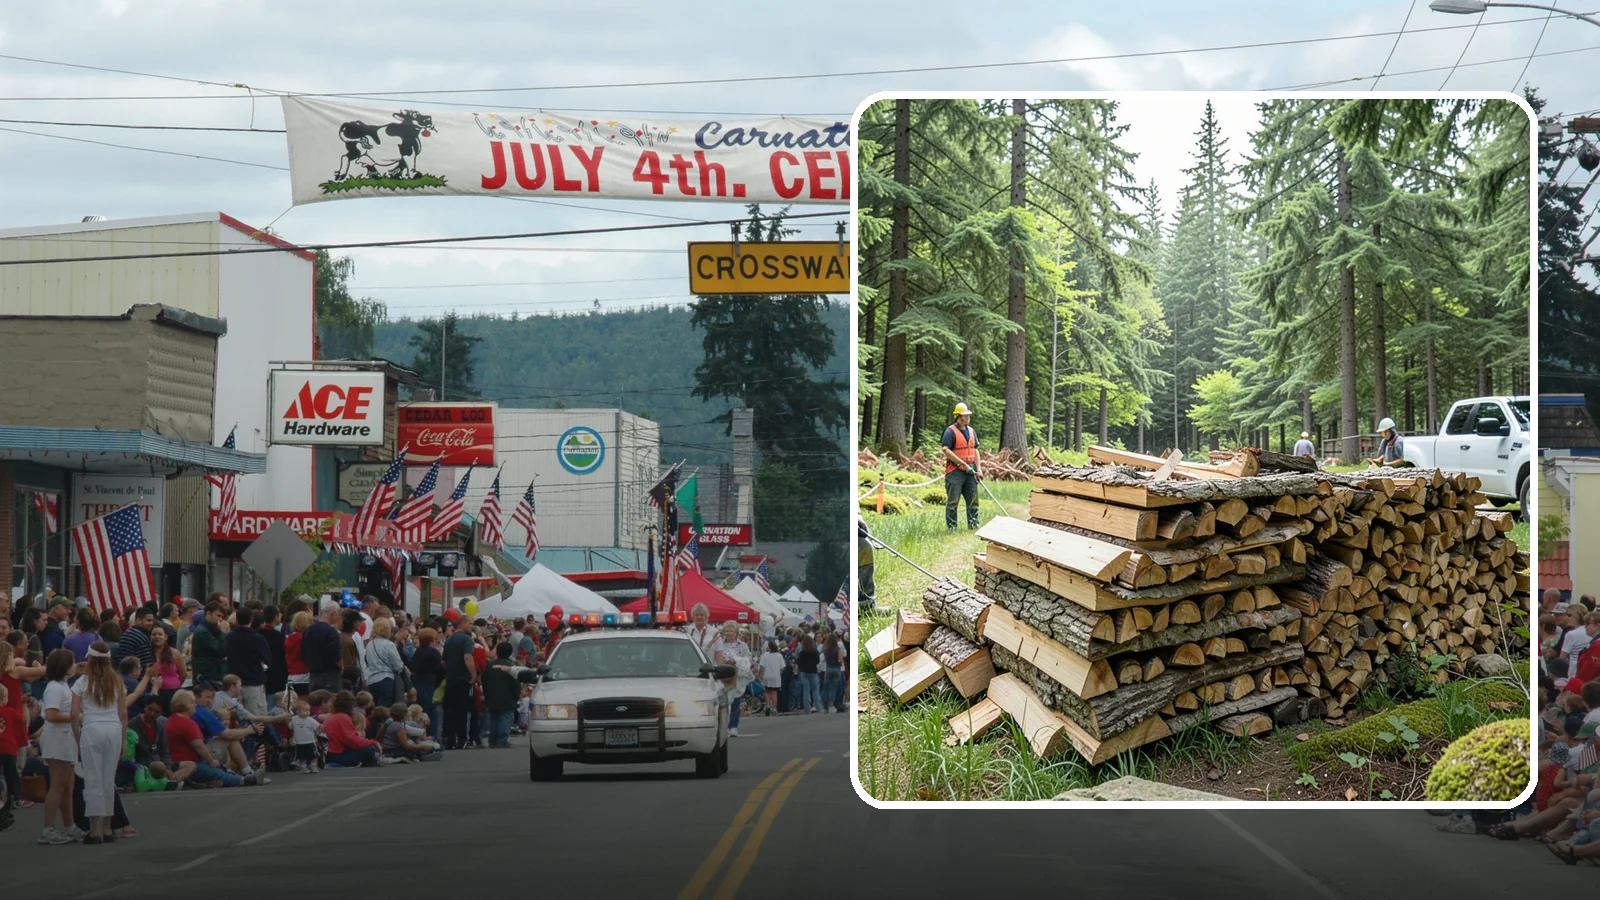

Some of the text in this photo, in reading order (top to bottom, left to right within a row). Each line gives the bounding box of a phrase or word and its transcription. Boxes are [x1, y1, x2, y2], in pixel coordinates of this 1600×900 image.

[694, 121, 850, 150] Carnat
[481, 141, 605, 193] JULY
[632, 150, 746, 198] 4th.
[697, 254, 850, 280] CROSSWA
[283, 380, 374, 420] ACE
[405, 409, 452, 422] CEDAR
[283, 421, 371, 436] Hardware
[416, 428, 477, 447] Coca-Cola
[353, 467, 386, 480] Simpl
[95, 485, 124, 495] Vincent
[126, 486, 136, 495] de
[137, 485, 155, 495] Paul
[213, 516, 331, 535] HARDARE
[688, 526, 741, 535] CRNATION
[699, 535, 730, 543] GLASS
